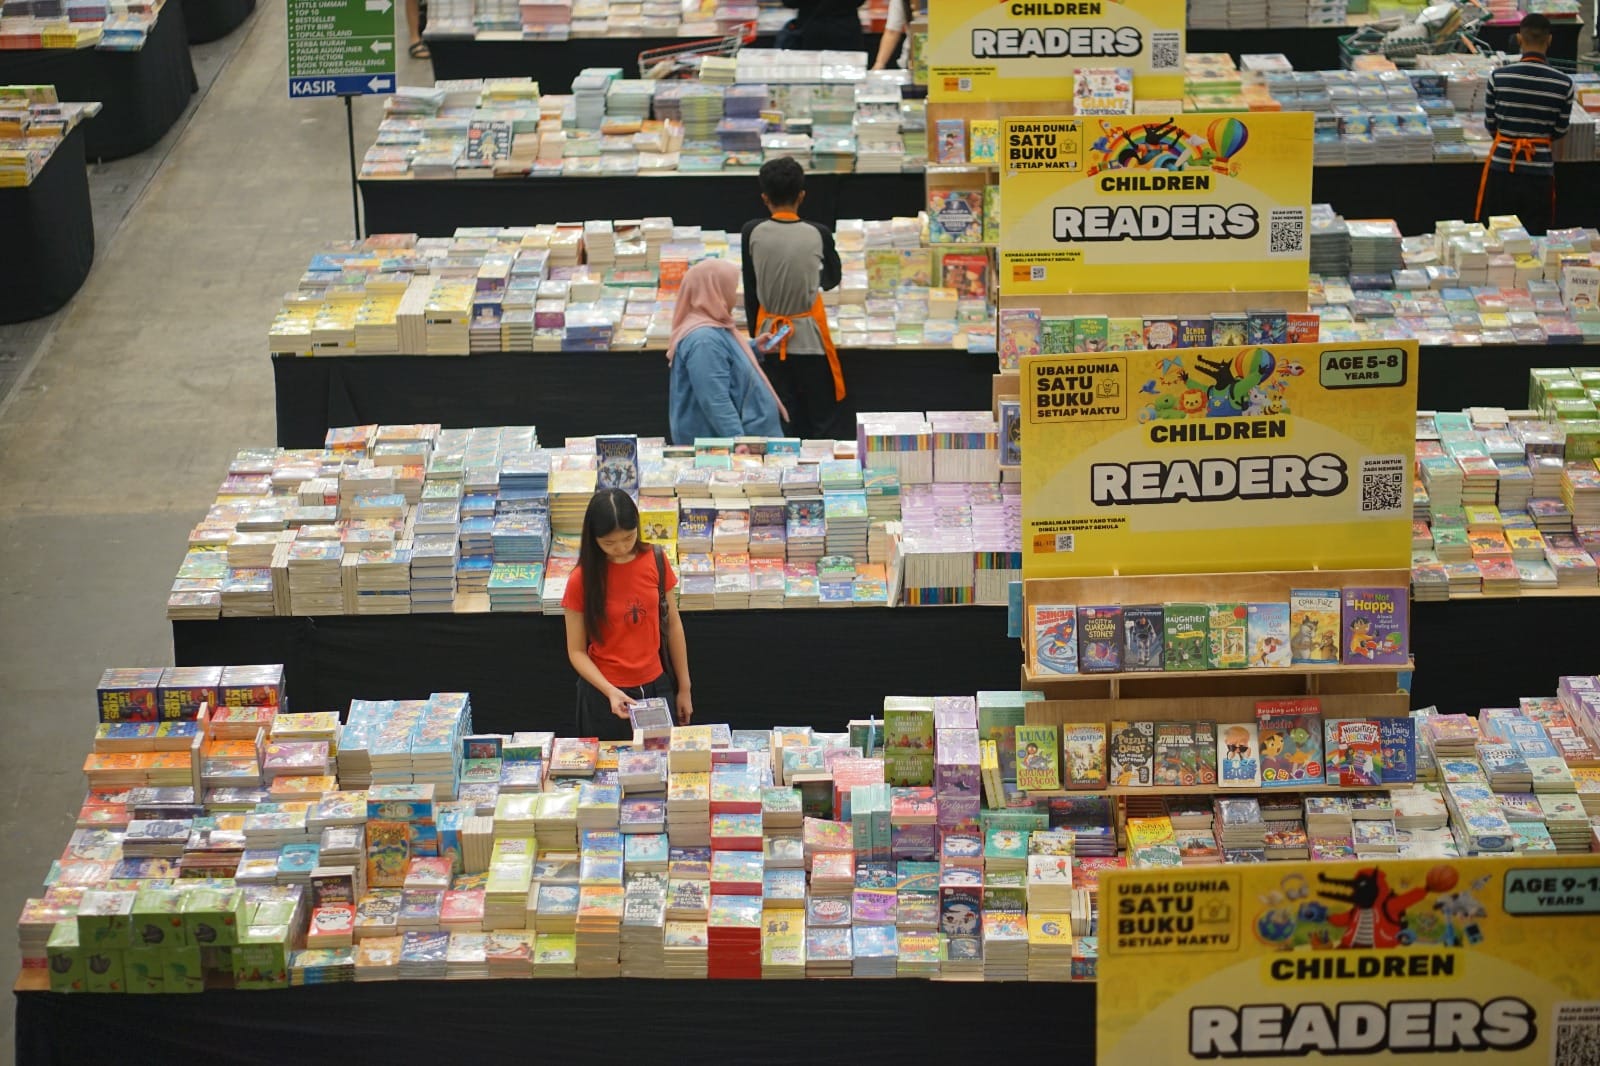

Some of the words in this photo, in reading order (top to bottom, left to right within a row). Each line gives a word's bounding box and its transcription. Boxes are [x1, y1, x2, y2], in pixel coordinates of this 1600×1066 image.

[1011, 3, 1100, 15] CHILDREN
[972, 27, 1142, 58] READERS
[292, 81, 336, 94] KASIR
[1043, 124, 1076, 132] DUNIA
[1010, 134, 1056, 146] SATU
[1010, 148, 1056, 159] BUKU
[1101, 176, 1209, 191] CHILDREN
[1053, 204, 1259, 242] READERS
[1037, 365, 1074, 376] UBAH
[1077, 363, 1119, 374] DUNIA
[1326, 356, 1363, 370] AGE
[1366, 355, 1398, 369] 5-8
[1344, 371, 1379, 380] YEARS
[1037, 376, 1092, 391] SATU
[1037, 392, 1093, 408] BUKU
[1038, 408, 1078, 417] SETIAP
[1080, 406, 1120, 415] WAKTU
[1150, 421, 1286, 443] CHILDREN
[1091, 453, 1348, 507] READERS
[1354, 600, 1394, 613] Happy
[109, 692, 119, 719] KIDS
[169, 690, 180, 717] KIDS
[1258, 707, 1284, 715] Reading
[1343, 724, 1376, 734] NAUGHTIEST
[1392, 723, 1409, 737] Fairy
[941, 800, 976, 810] Beloved
[1118, 883, 1169, 895] UBAH
[1173, 880, 1230, 893] DUNIA
[1510, 878, 1557, 893] AGE
[1562, 877, 1600, 892] 9-1
[1118, 896, 1194, 914] SATU
[1537, 896, 1584, 906] YEARS
[1118, 916, 1194, 935] BUKU
[1118, 936, 1173, 947] SETIAP
[1177, 934, 1230, 946] WAKTU
[1271, 954, 1455, 981] CHILDREN
[1189, 997, 1537, 1059] READERS
